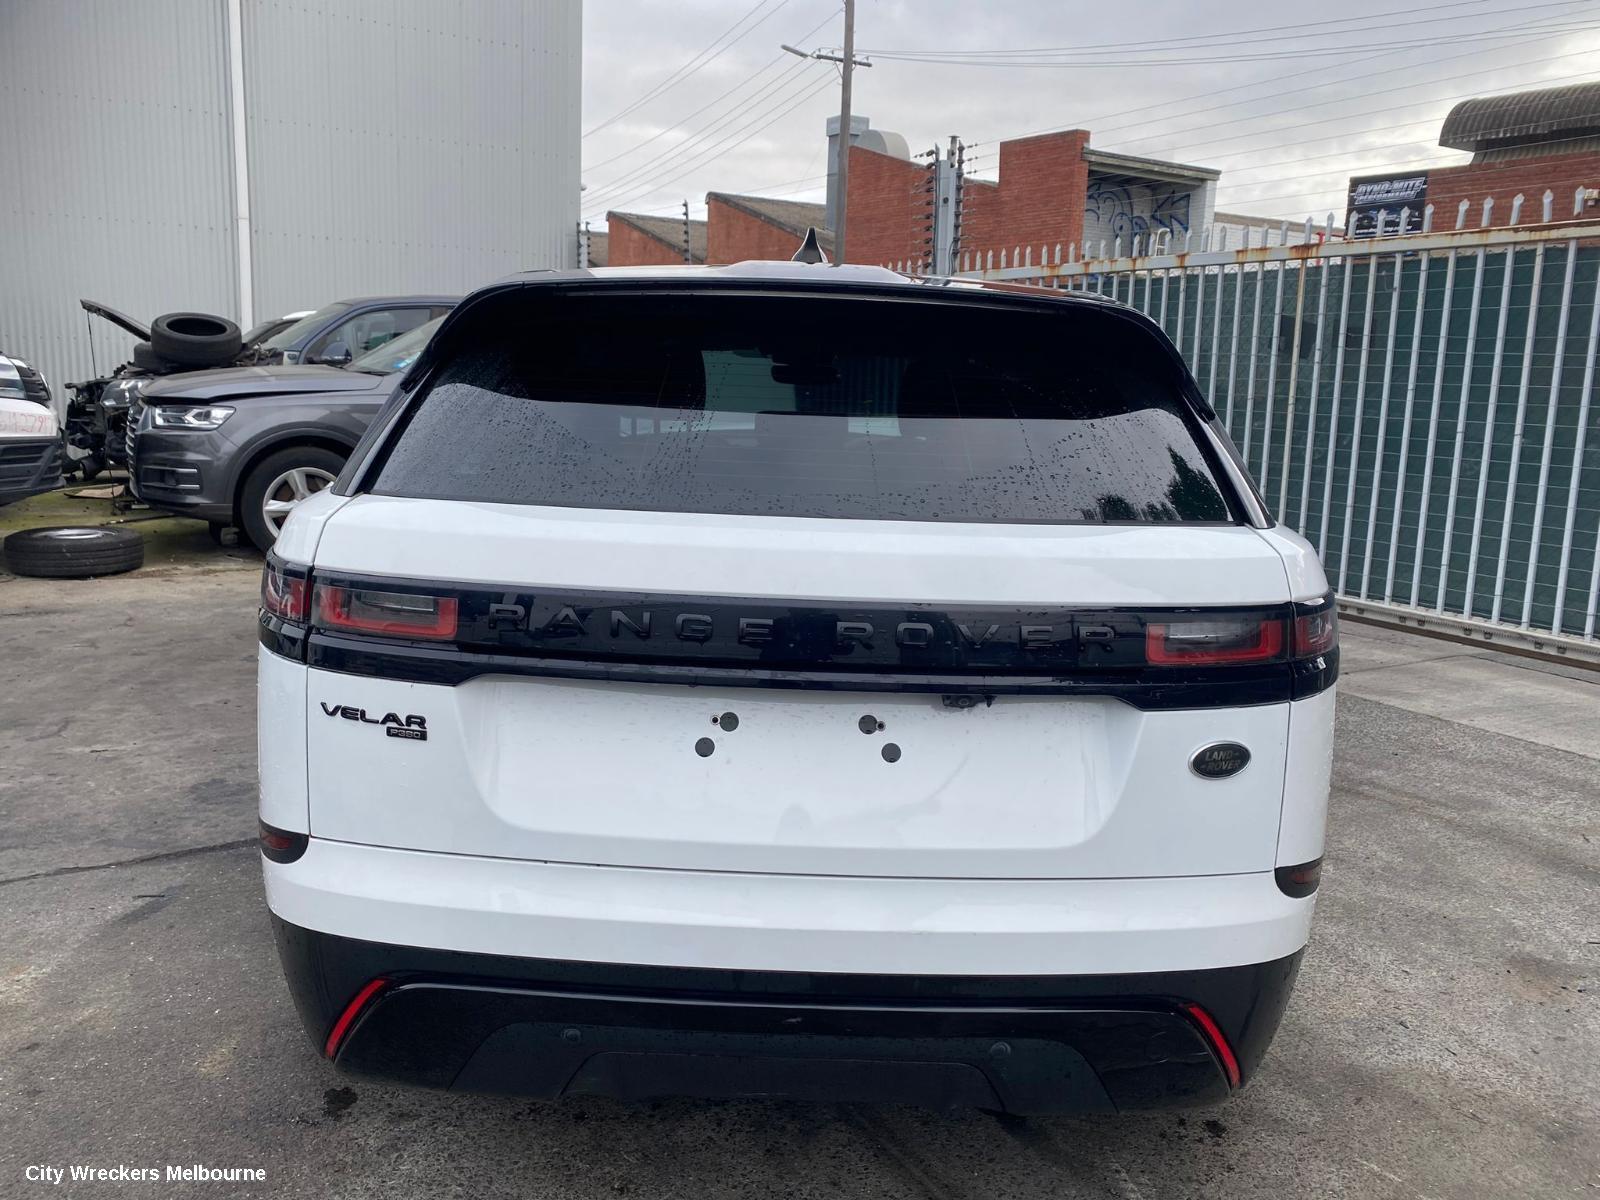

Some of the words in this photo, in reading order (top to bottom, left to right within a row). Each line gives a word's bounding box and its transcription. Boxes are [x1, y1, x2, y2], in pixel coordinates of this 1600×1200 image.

[488, 602, 774, 644] RANGE
[834, 620, 1116, 652] ROVER
[320, 701, 427, 729] VELAR
